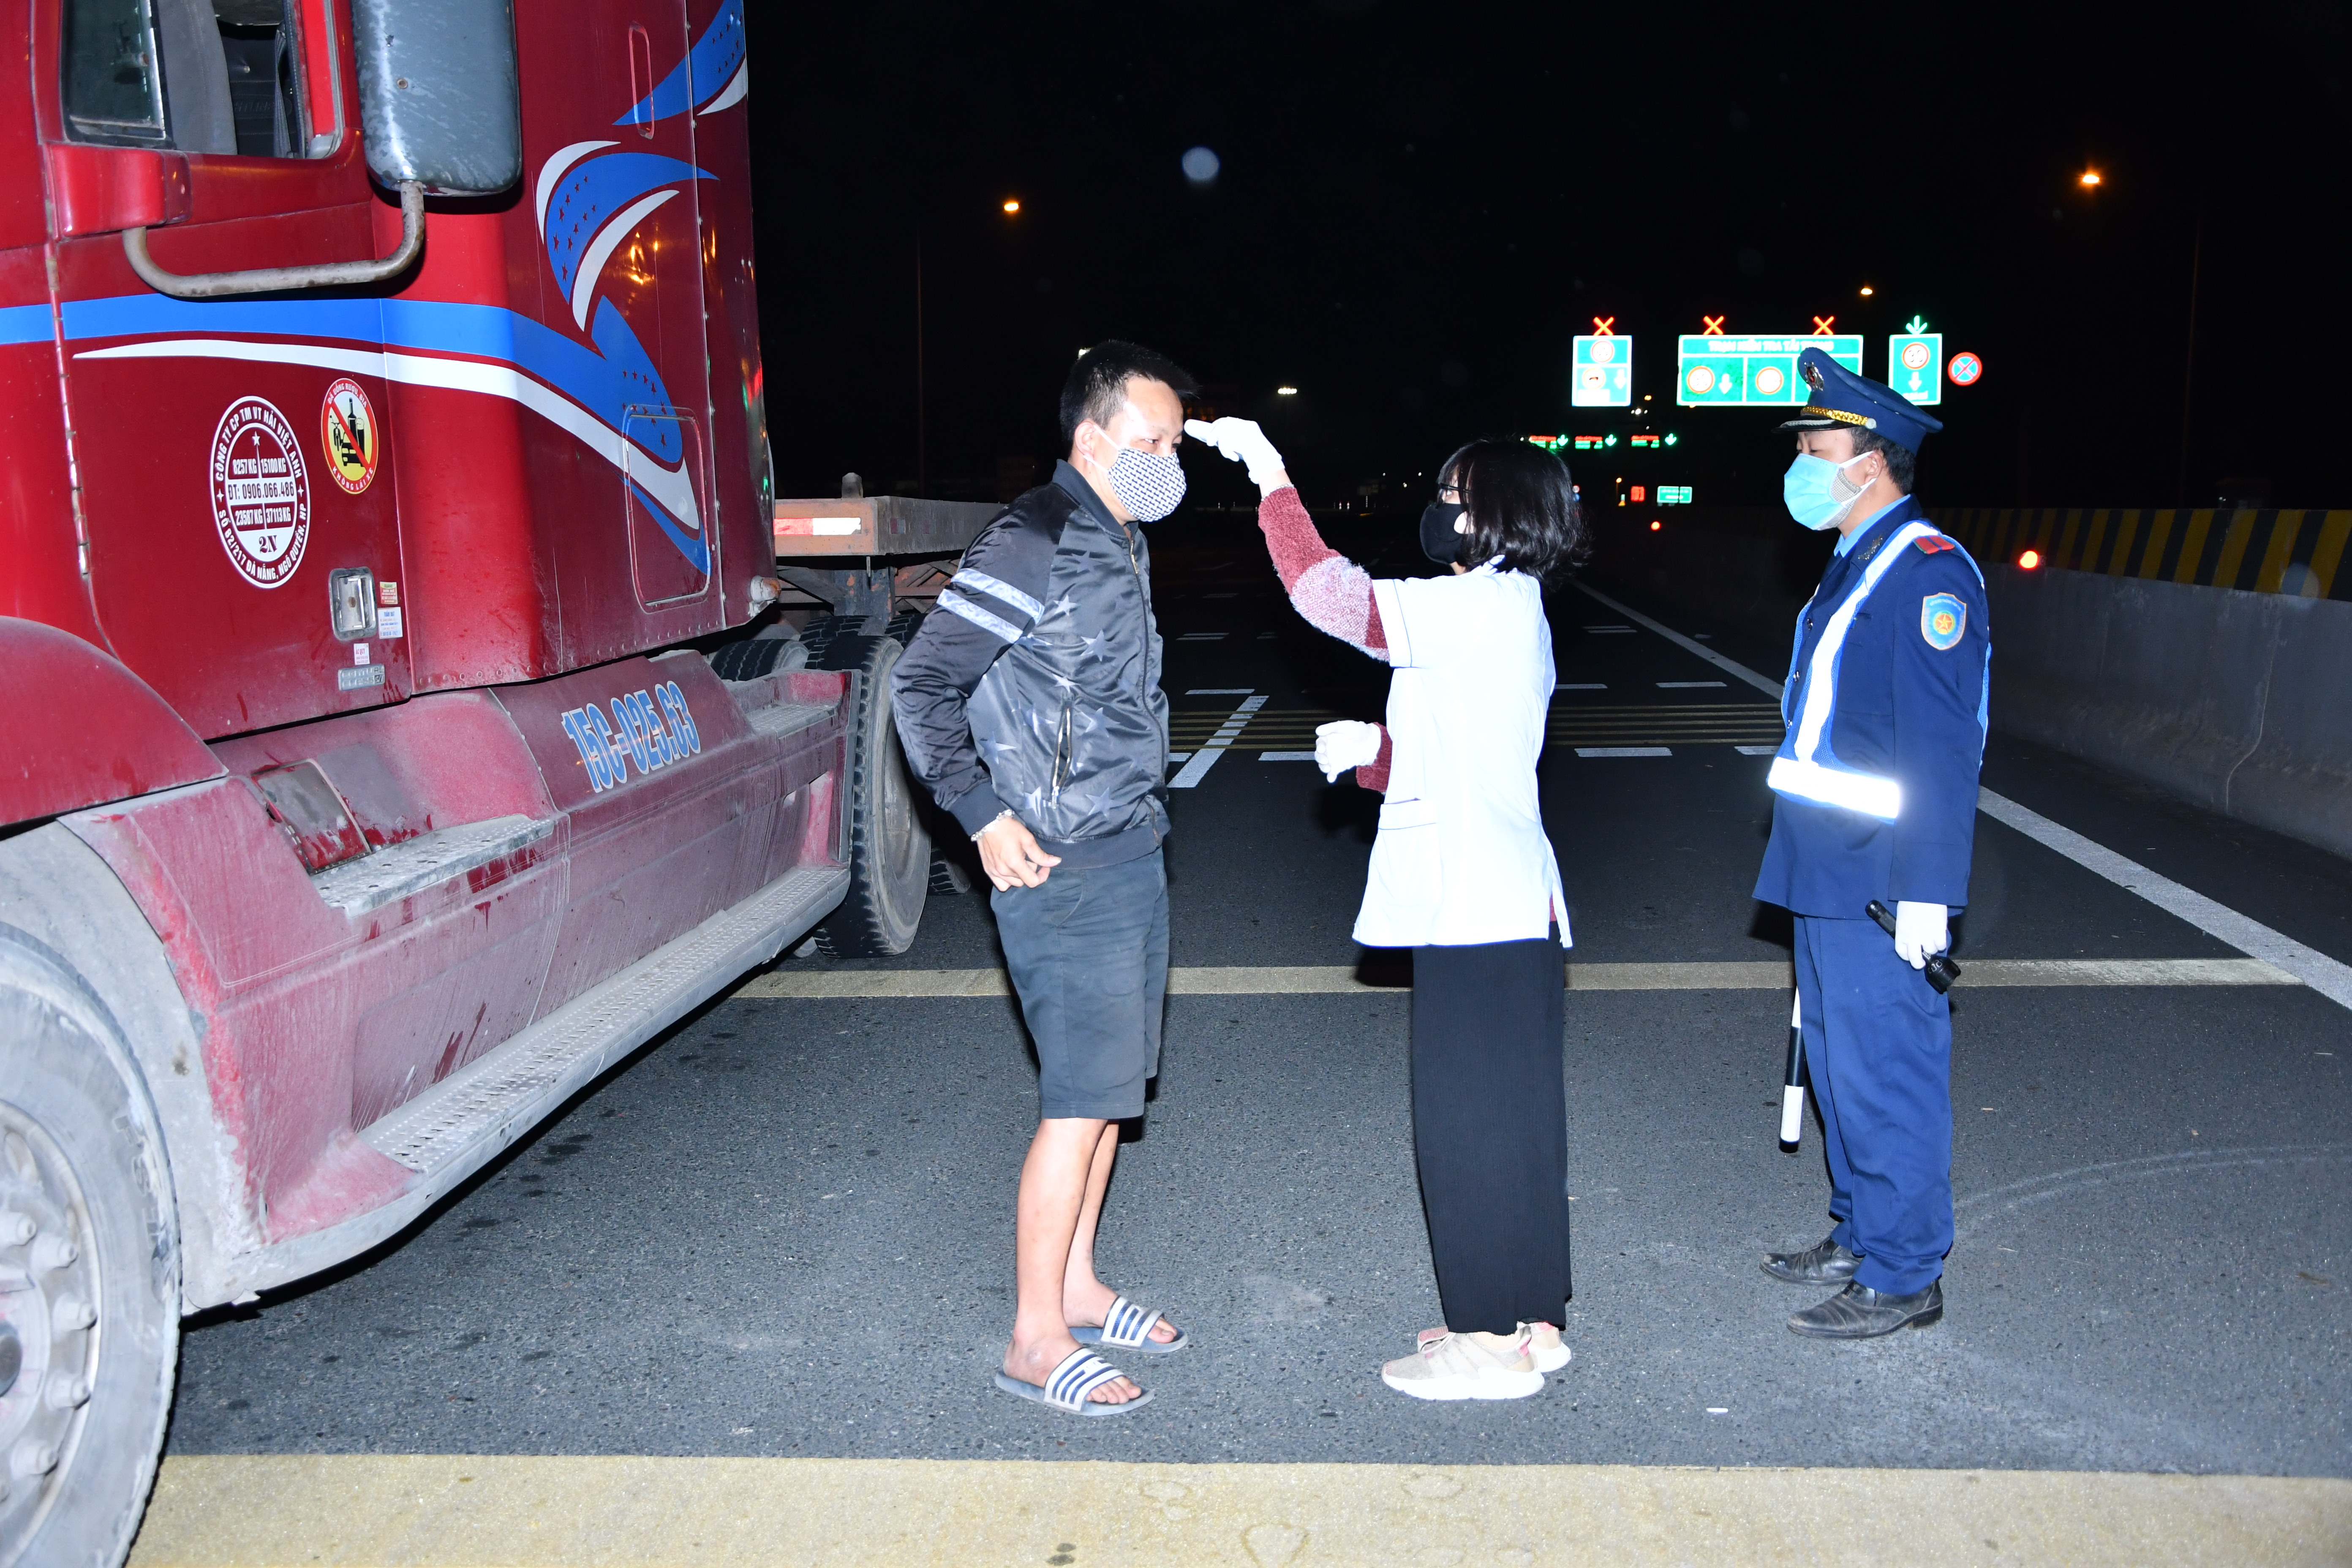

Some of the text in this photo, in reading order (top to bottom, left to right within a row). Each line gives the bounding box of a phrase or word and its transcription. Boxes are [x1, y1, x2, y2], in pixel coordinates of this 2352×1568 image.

[1908, 350, 1923, 362] 30
[333, 383, 344, 395] UỐNG
[215, 406, 302, 481] CÔNG TY CP TM VT HẢI VIỆT ANH
[332, 466, 373, 490] KHÔNG LÁI XE
[228, 481, 294, 500] ĐT: 0906.066.486
[219, 509, 231, 528] SỐ
[299, 503, 306, 520] HP
[561, 680, 701, 793] 15C-025.63
